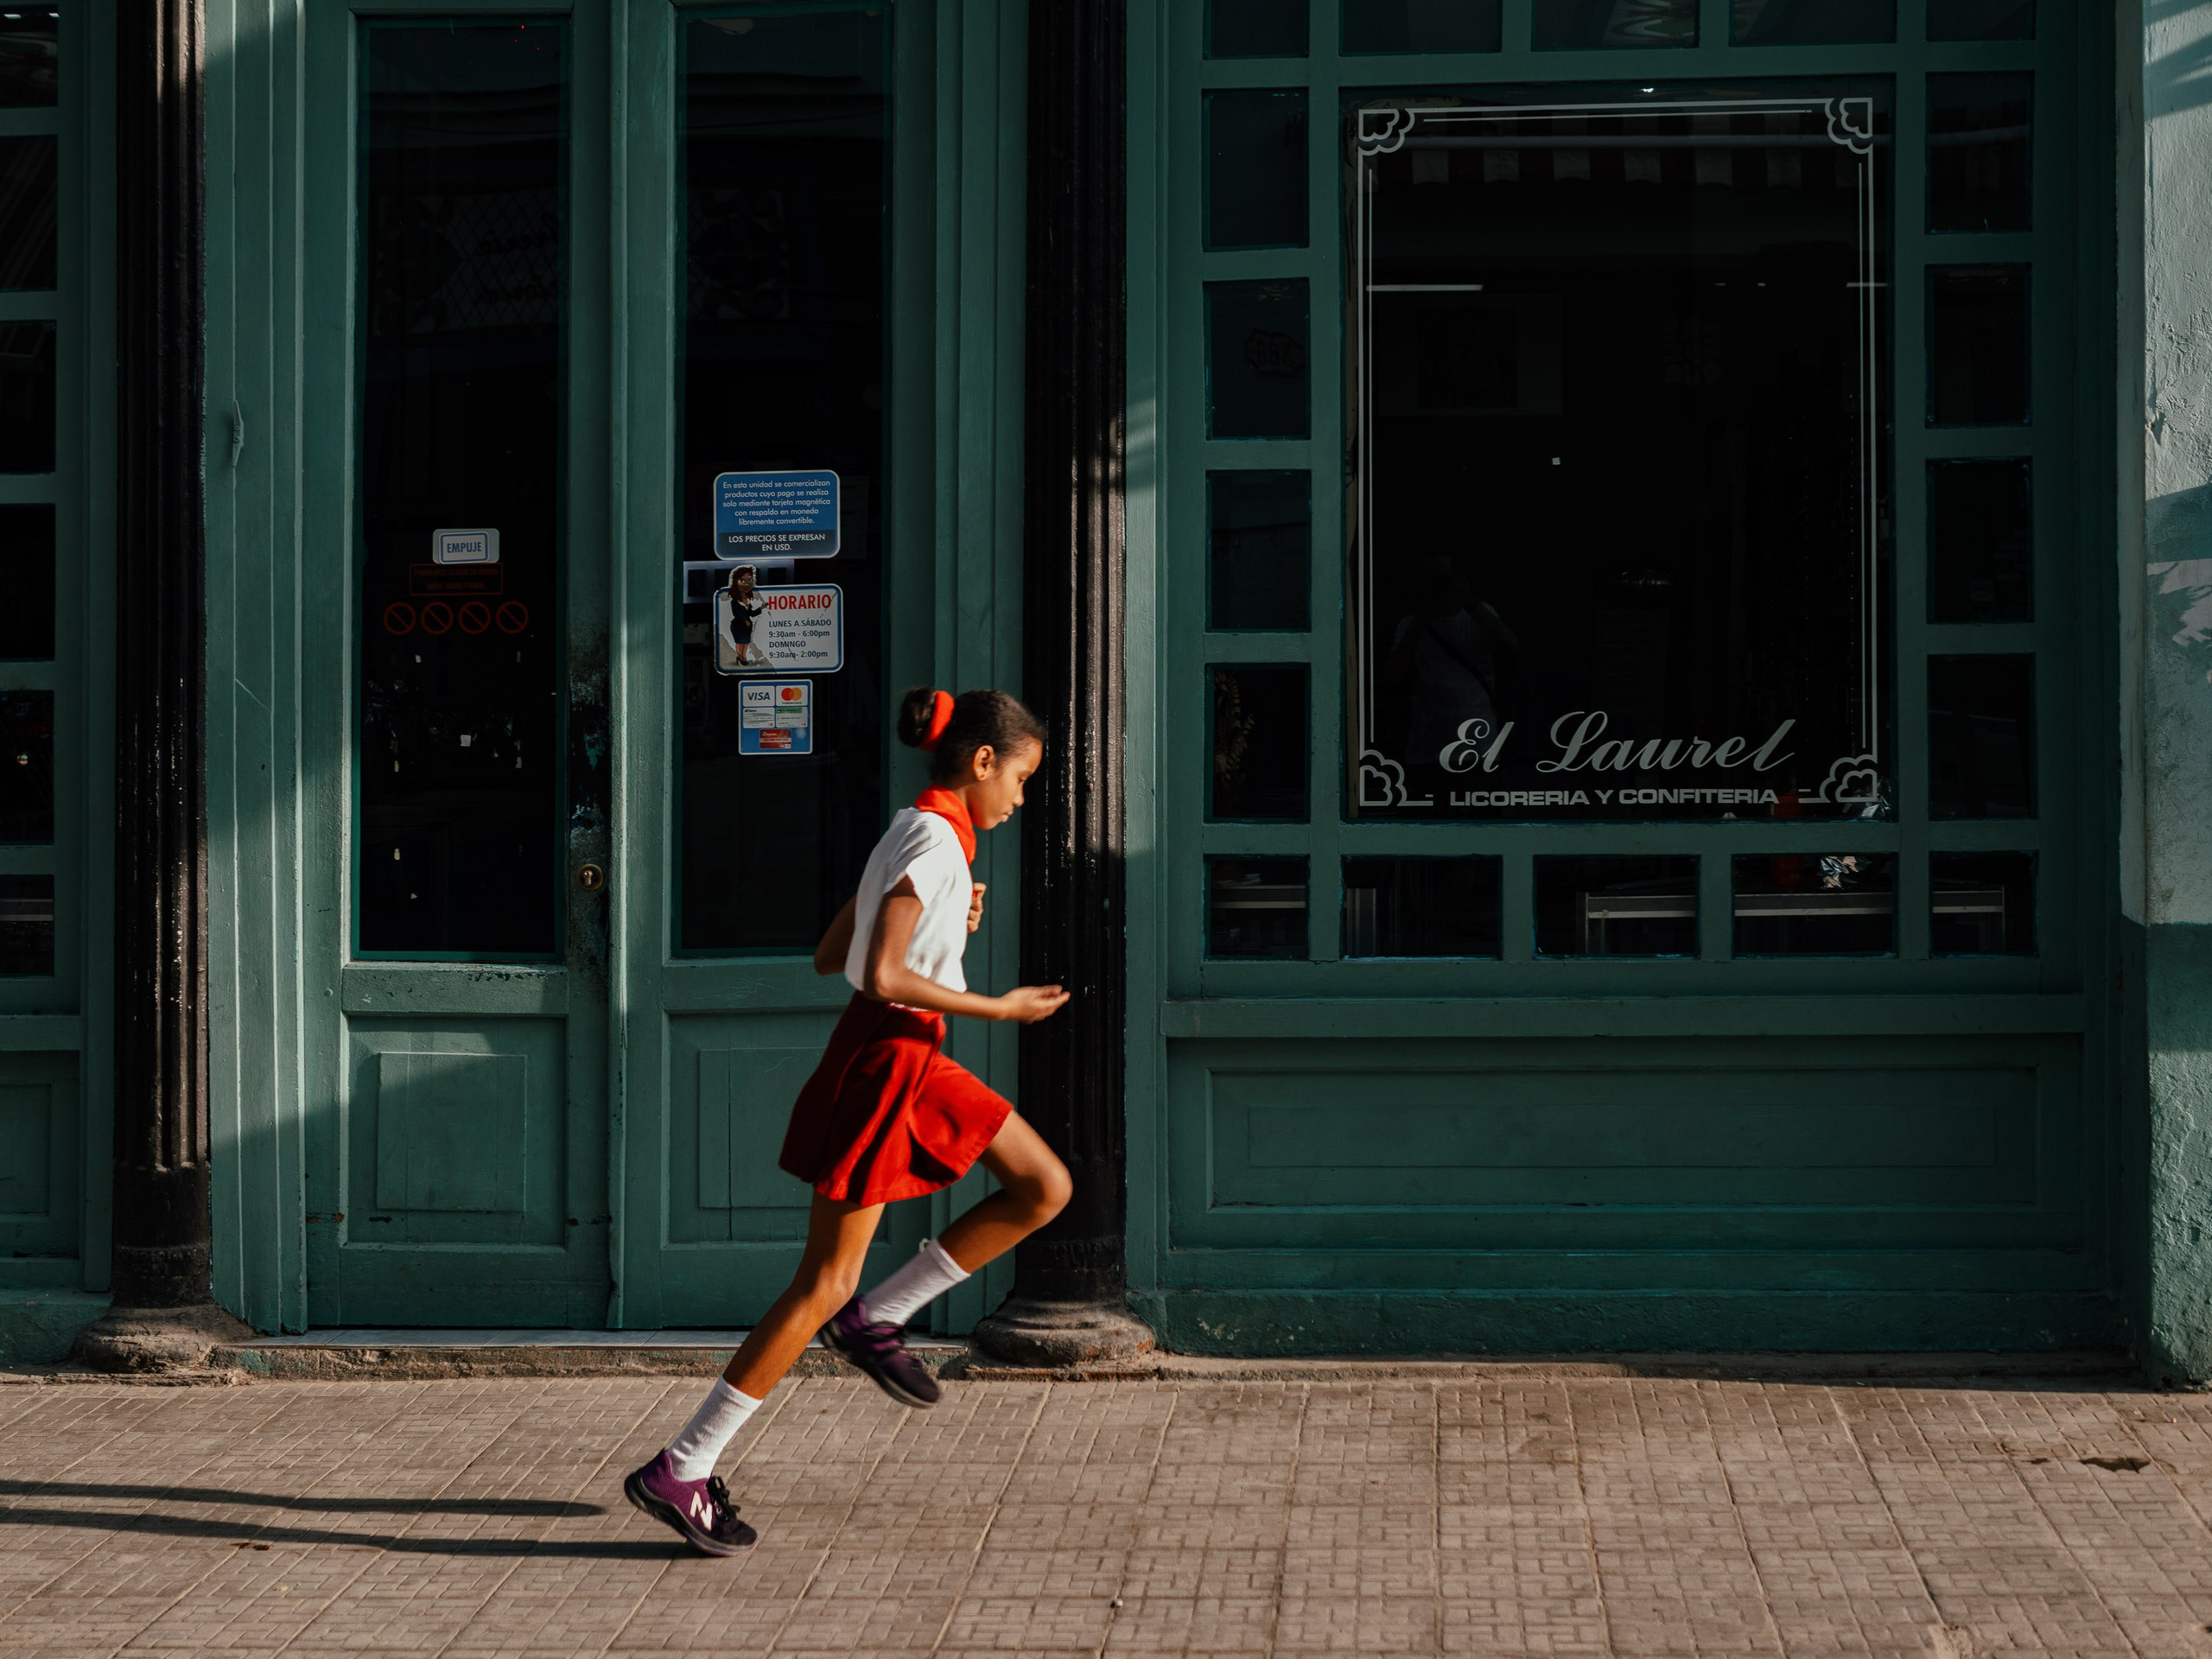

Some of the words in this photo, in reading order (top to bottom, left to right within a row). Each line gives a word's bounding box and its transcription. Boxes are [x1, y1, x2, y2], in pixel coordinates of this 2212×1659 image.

[447, 542, 481, 553] EMPUJE
[768, 594, 831, 610] HORARIO
[802, 618, 831, 626] SÁBADO
[747, 692, 770, 701] VISA
[1439, 717, 1515, 773] El
[1536, 710, 1796, 772] Laurel
[1450, 790, 1587, 807] LICORERIA
[1589, 790, 1612, 805] Y
[1619, 788, 1780, 805] CONFITERIA
